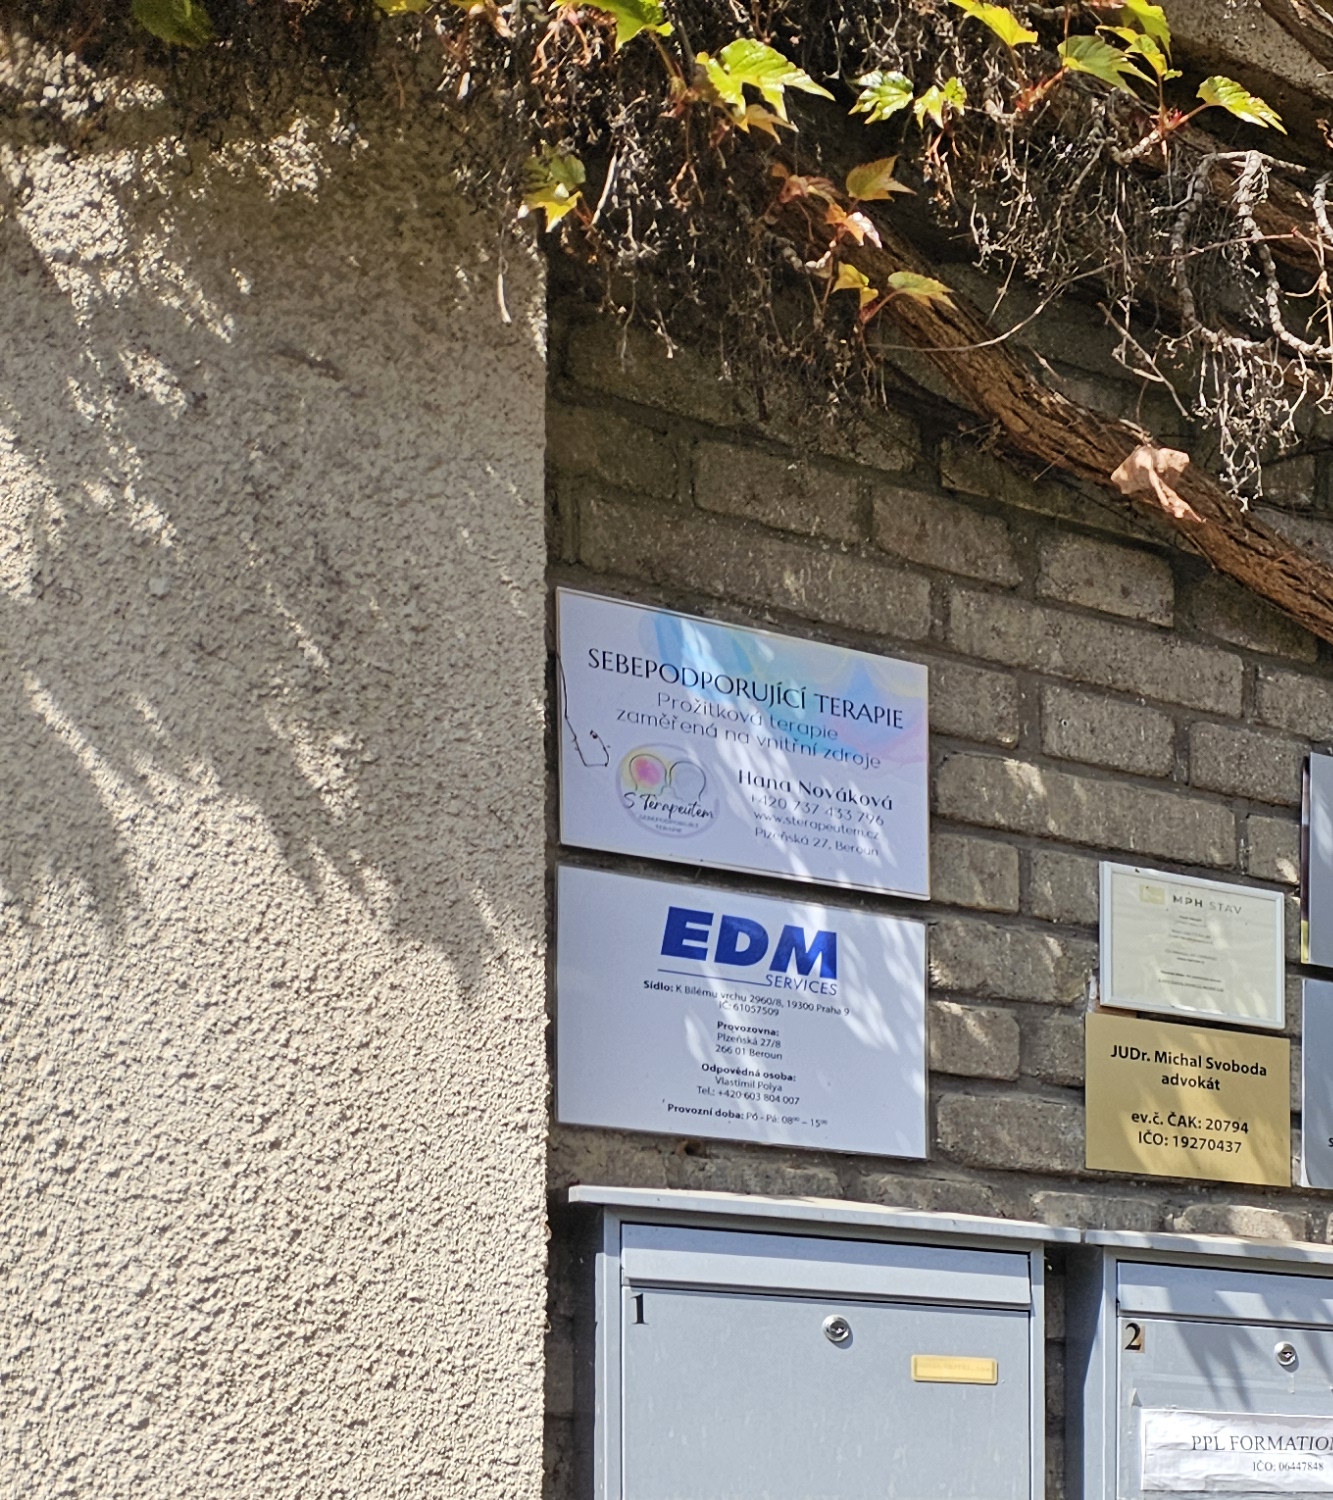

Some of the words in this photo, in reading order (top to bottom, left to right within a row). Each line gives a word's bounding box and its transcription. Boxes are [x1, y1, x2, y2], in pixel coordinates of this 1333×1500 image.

[588, 647, 806, 710] SEBEPODPORUJÍCÍ
[813, 693, 903, 729] TERAPIE
[657, 691, 762, 726] Prožitková
[770, 715, 838, 740] terapie
[616, 708, 717, 739] zaměřená
[725, 729, 749, 744] na
[756, 734, 817, 756] vnitřní
[823, 747, 881, 770] zdroje
[738, 769, 791, 793] Hana
[799, 780, 893, 811] Nováková
[751, 794, 787, 810] +420
[793, 801, 819, 815] 737
[825, 806, 852, 821] 433
[857, 811, 884, 827] 796
[835, 840, 879, 856] Beroun
[1172, 894, 1203, 908] MPH
[1209, 901, 1242, 915] STAV
[660, 906, 838, 980] EDM
[765, 974, 838, 996] SERVICES
[643, 979, 674, 992] Sídlo:
[675, 984, 682, 994] K
[720, 990, 747, 1002] vrchu
[787, 1000, 815, 1012] 19300
[816, 1003, 842, 1015] Praha
[843, 1006, 850, 1016] 9
[717, 1021, 779, 1037] Provozovna:
[715, 1044, 733, 1055] 266
[735, 1046, 746, 1056] 01
[749, 1047, 783, 1060] Beroun
[760, 1037, 781, 1049] 27/8
[1110, 1044, 1151, 1062] JUDr.
[1154, 1050, 1202, 1068] Michal
[1206, 1056, 1268, 1077] Svoboda
[701, 1063, 760, 1078] Odpovědná
[763, 1070, 796, 1082] osoba:
[715, 1075, 755, 1089] Vlastimil
[1161, 1073, 1221, 1091] advokát
[718, 1088, 742, 1099] +420
[743, 1091, 761, 1102] 603
[782, 1095, 800, 1106] 007
[667, 1103, 713, 1117] Provozní
[715, 1108, 744, 1120] doba:
[1167, 1111, 1202, 1129] ČAK:
[1205, 1118, 1249, 1134] 20794
[1138, 1130, 1169, 1147] IČO:
[1172, 1135, 1243, 1154] 19270437
[630, 1293, 649, 1326] 1
[1125, 1322, 1142, 1351] 2
[1191, 1435, 1226, 1451] PPL
